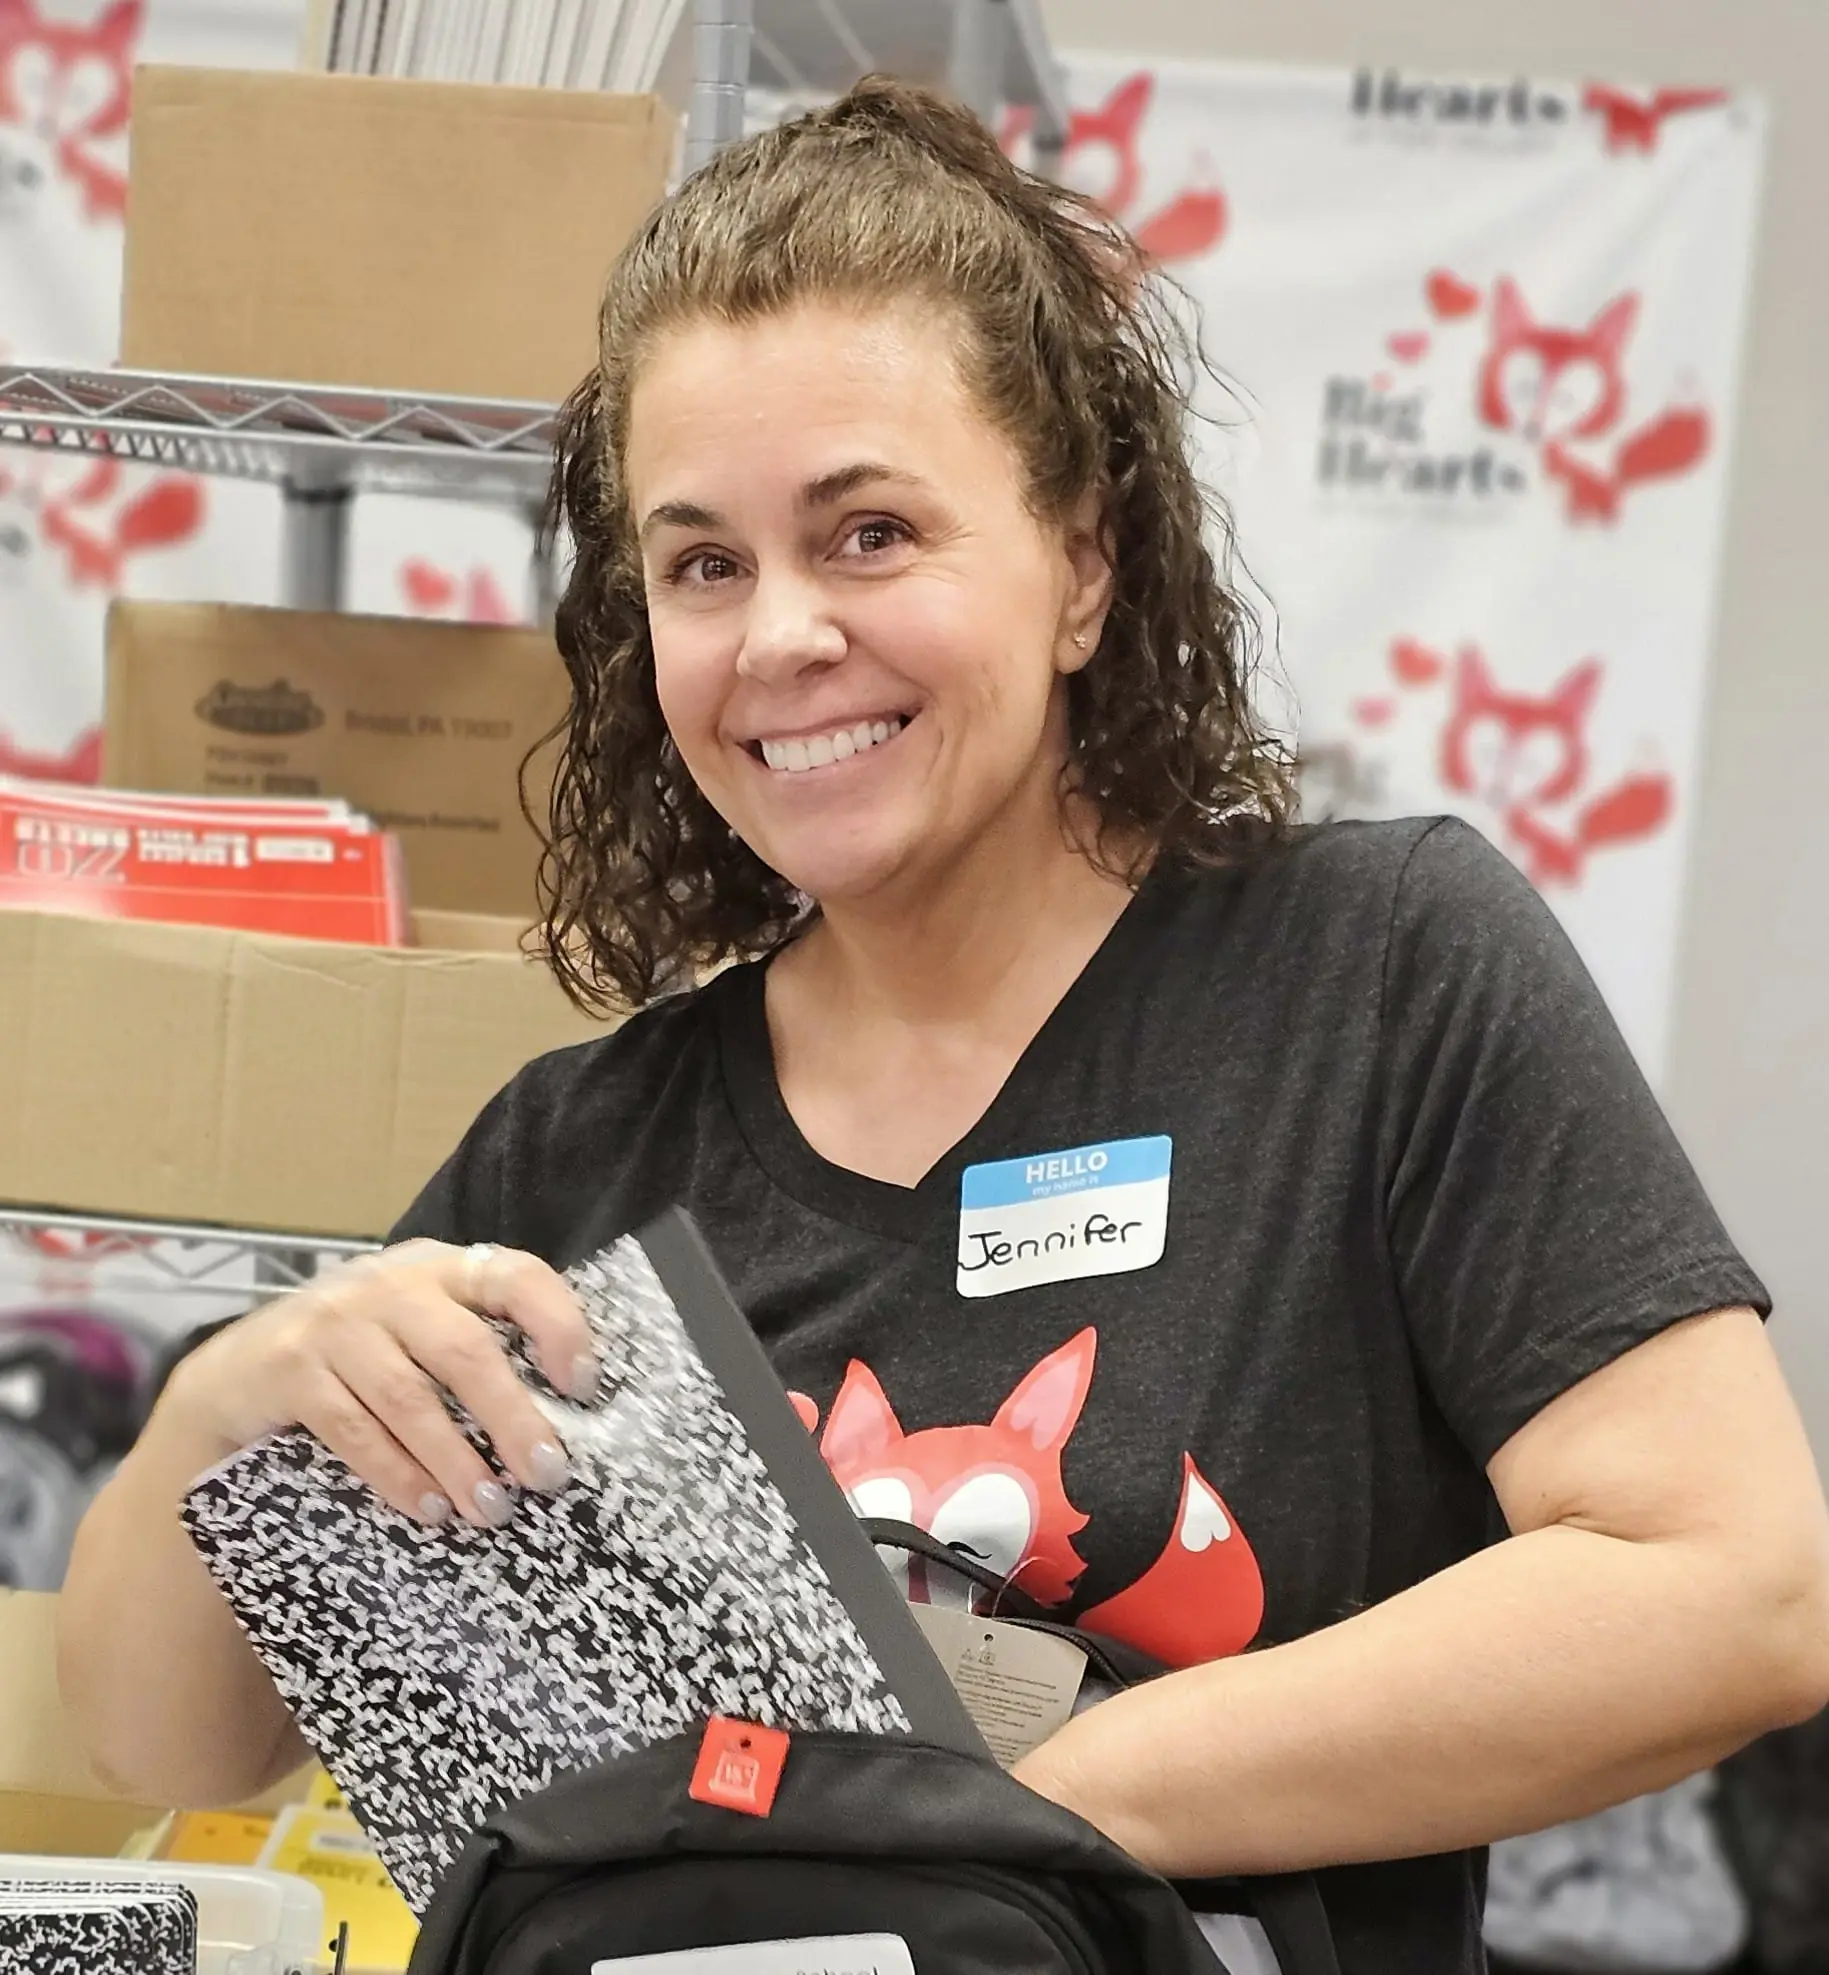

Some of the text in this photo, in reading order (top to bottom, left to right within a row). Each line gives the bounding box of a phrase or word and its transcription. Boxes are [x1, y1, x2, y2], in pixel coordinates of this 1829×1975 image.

[1026, 1151, 1107, 1184] HELLO
[1032, 1175, 1099, 1197] my name is
[959, 1214, 1142, 1271] Jennifer
